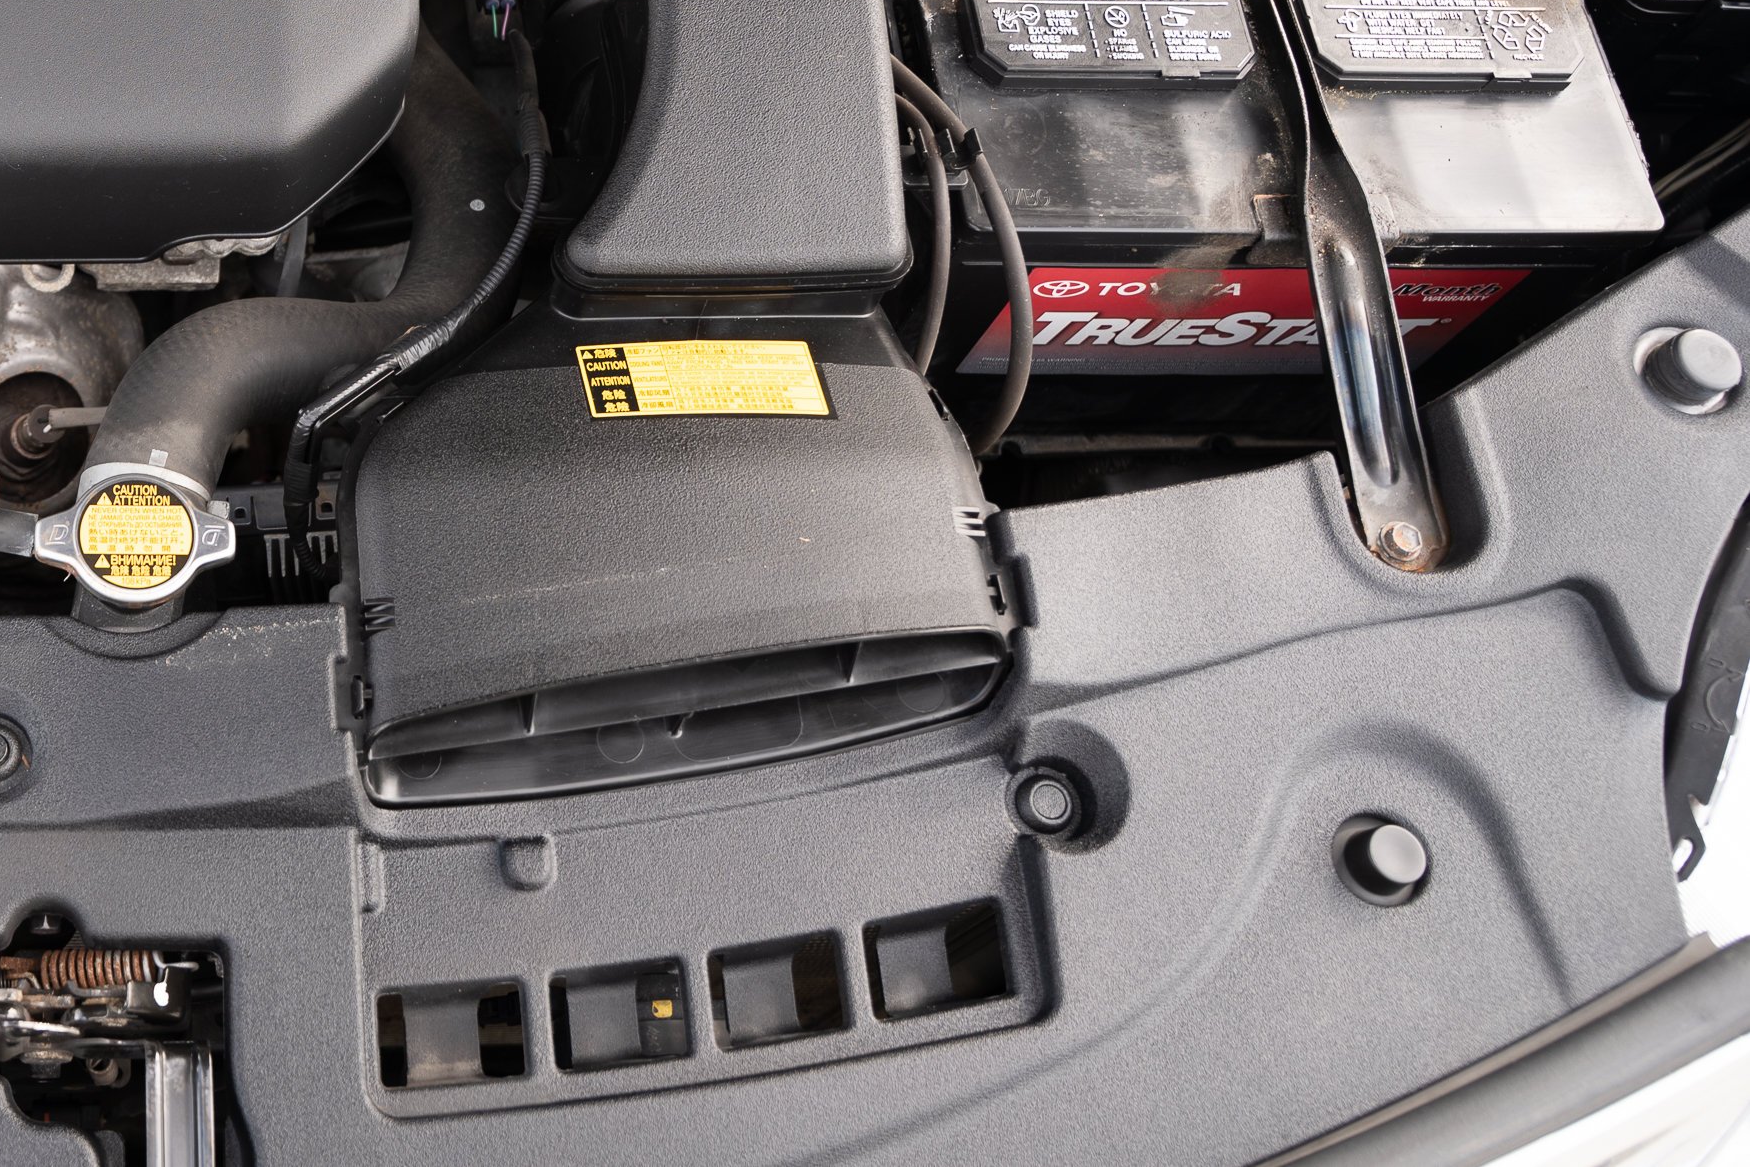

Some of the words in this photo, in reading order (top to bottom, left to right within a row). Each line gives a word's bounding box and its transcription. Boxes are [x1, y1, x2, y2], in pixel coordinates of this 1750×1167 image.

[1045, 9, 1079, 18] SHIELD
[1047, 18, 1072, 26] EYES
[1028, 26, 1079, 35] EXPLOSIVE
[1112, 29, 1127, 37] NO
[1164, 30, 1209, 39] SULFURIC
[1210, 30, 1231, 39] ACID
[1029, 35, 1062, 43] GASES
[1099, 282, 1241, 296] TOA
[586, 361, 627, 371] CAUTION
[591, 376, 630, 386] ATTENTION
[113, 484, 158, 495] CAUTION
[113, 495, 171, 506] ATTENTION
[110, 555, 177, 566] ВНИМАНИЕ!
